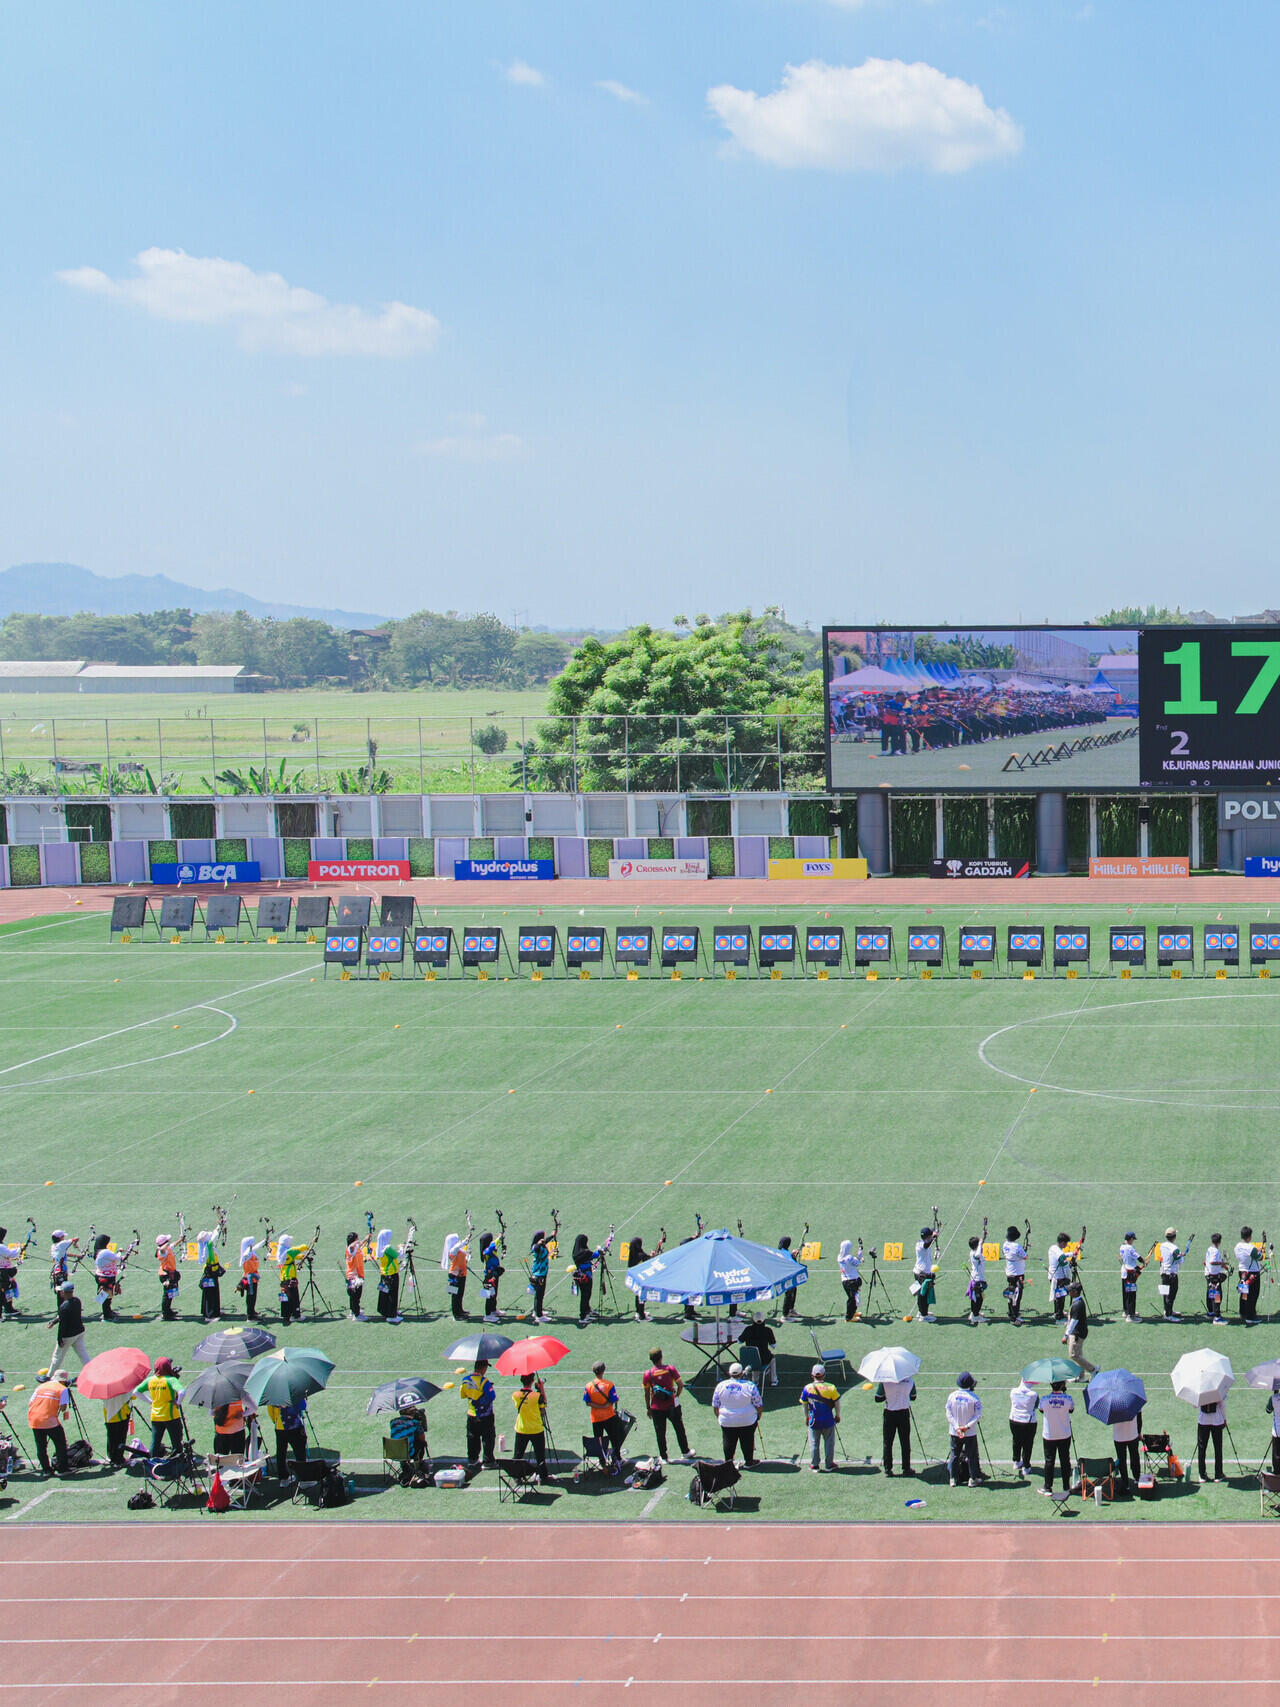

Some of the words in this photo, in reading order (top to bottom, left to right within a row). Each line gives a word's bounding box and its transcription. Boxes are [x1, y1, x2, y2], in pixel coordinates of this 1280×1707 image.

[1170, 731, 1190, 755] 2
[1162, 760, 1210, 771] KEJURNAS
[1212, 760, 1254, 771] PANAHAN
[198, 864, 237, 881] BCA
[319, 865, 399, 876] POLYTRON
[471, 861, 538, 876] hydroplus
[964, 867, 1012, 876] GADJAH
[1093, 864, 1137, 875] MilkLife
[1142, 864, 1186, 875] MilkLife
[885, 1244, 901, 1258] 32
[984, 1244, 998, 1258] 33
[713, 1267, 750, 1280] hydro
[725, 1276, 752, 1287] plus
